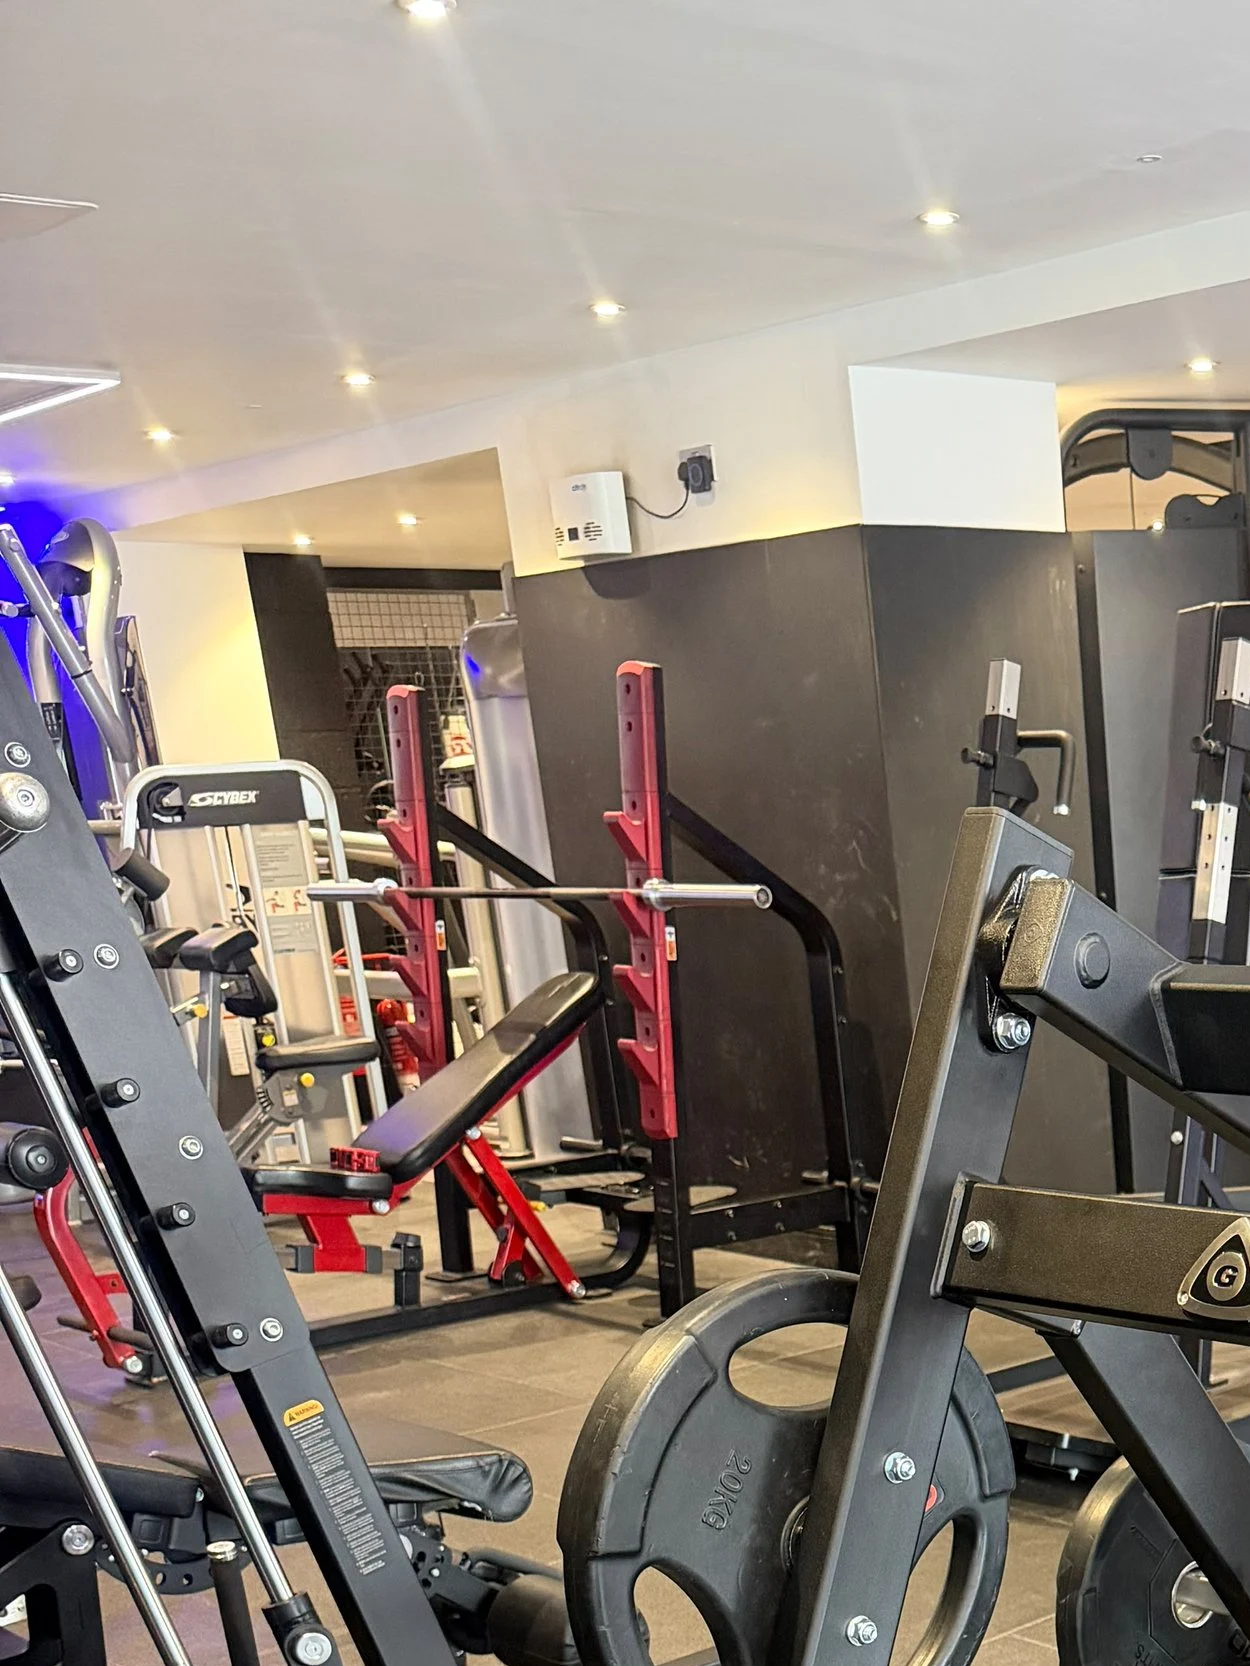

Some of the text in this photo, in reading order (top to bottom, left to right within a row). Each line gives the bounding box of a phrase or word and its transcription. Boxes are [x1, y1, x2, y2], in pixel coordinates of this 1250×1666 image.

[212, 790, 258, 806] CYBEX
[1213, 1265, 1239, 1288] G
[702, 1448, 752, 1531] 20KG
